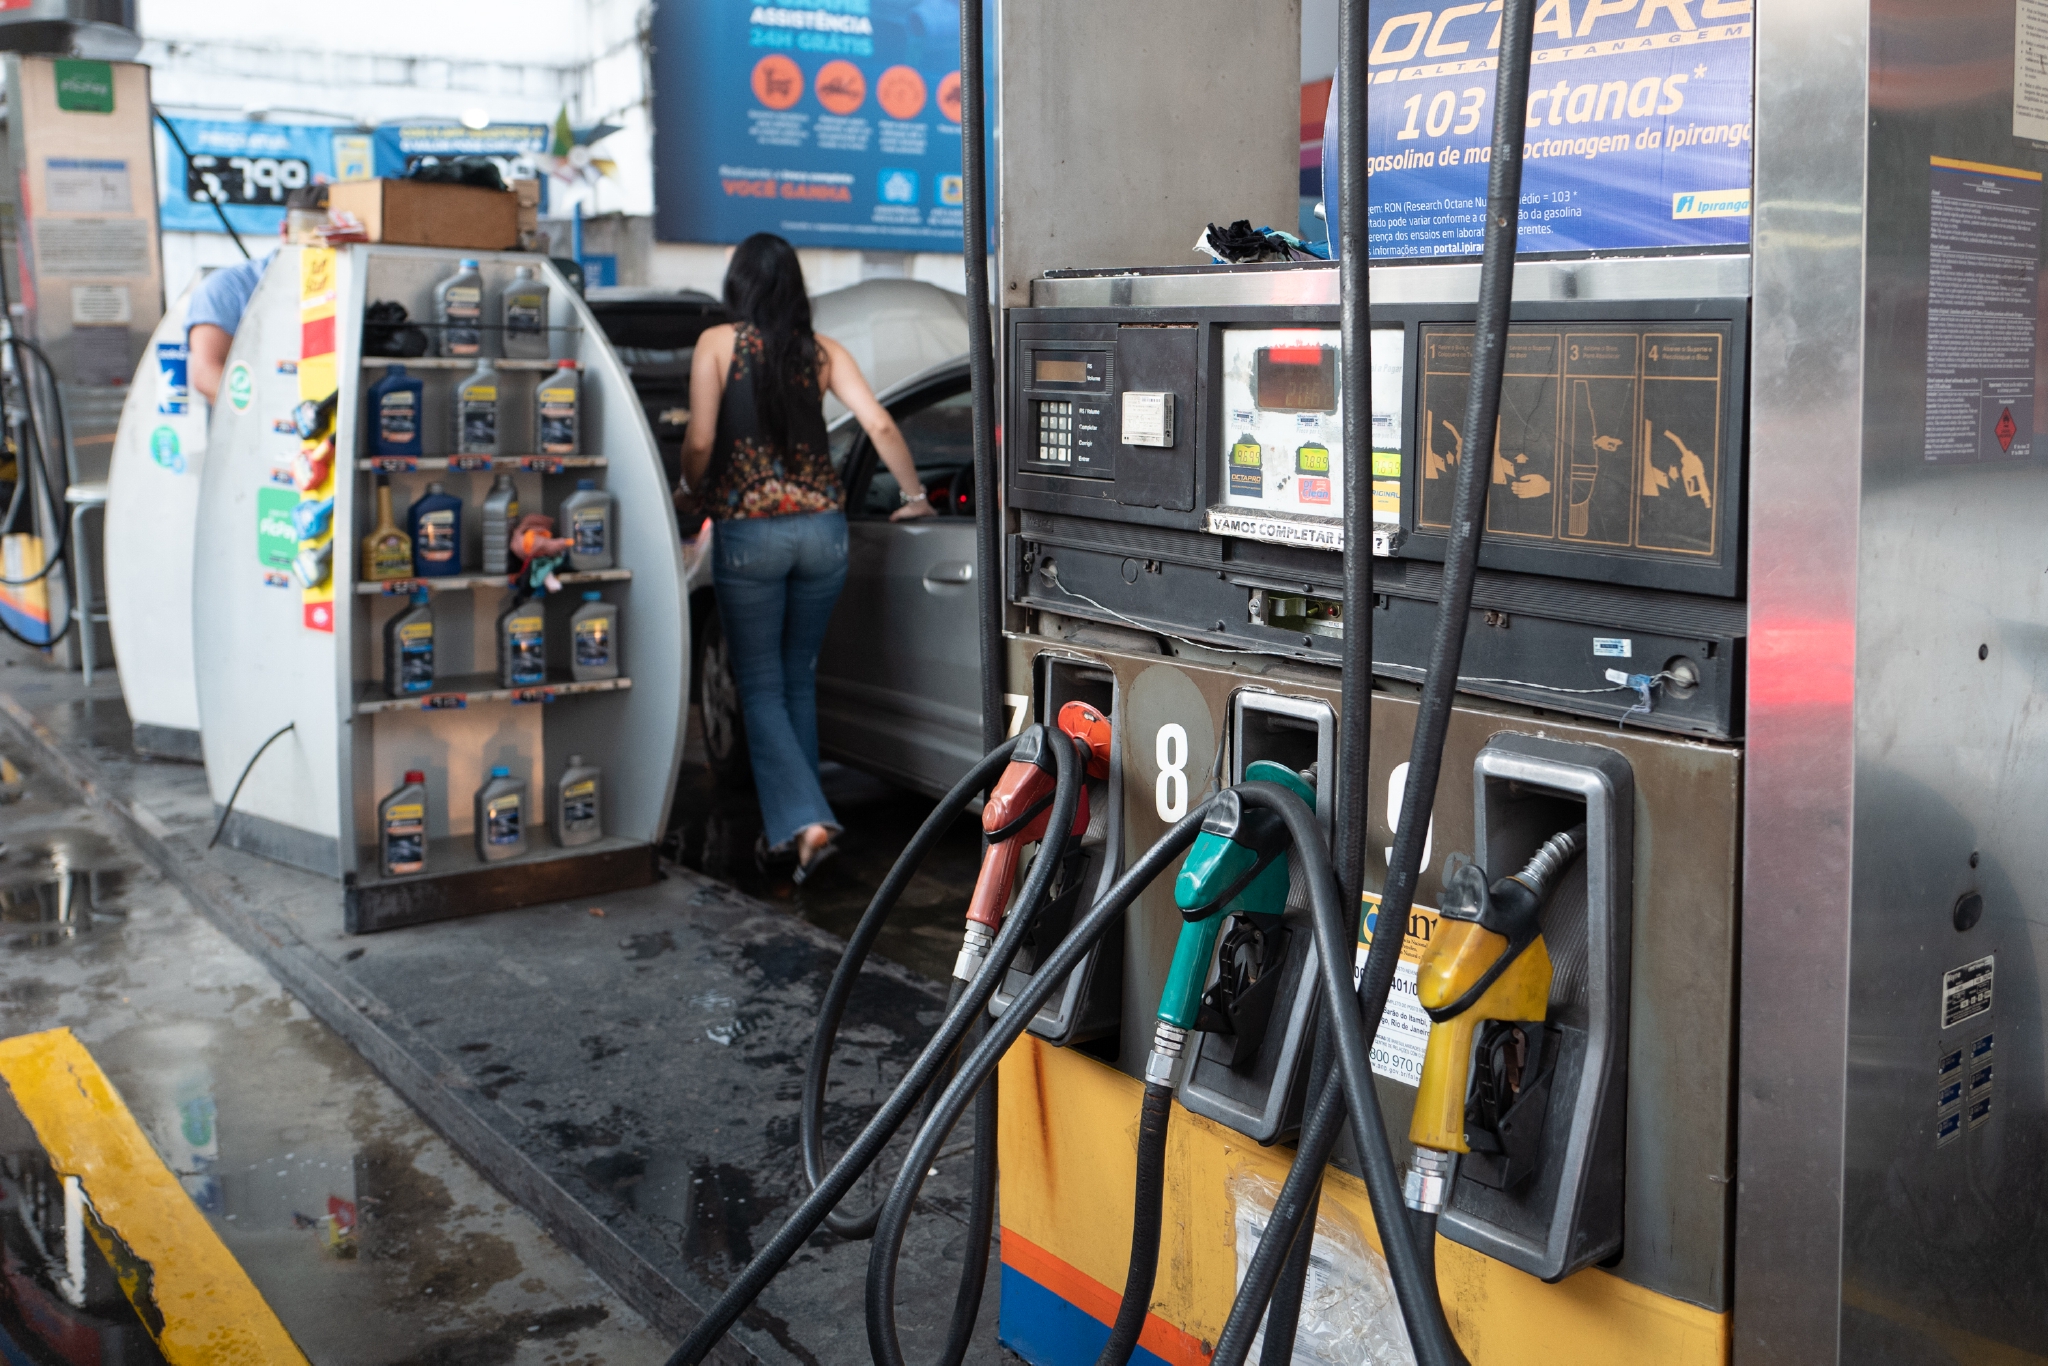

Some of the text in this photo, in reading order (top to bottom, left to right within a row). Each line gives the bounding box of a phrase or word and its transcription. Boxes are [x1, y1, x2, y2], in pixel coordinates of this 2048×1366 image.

[1412, 60, 1489, 77] ALTA
[1397, 87, 1486, 141] 103
[1438, 147, 1460, 166] de
[1635, 127, 1662, 150] da
[1551, 191, 1570, 203] 103
[1385, 202, 1402, 212] RON
[1403, 199, 1442, 214] (Research
[1444, 198, 1473, 210] Octane
[1531, 208, 1542, 219] da
[1544, 205, 1582, 221] gasolina
[1697, 200, 1750, 214] Ipiranga
[1388, 216, 1407, 230] pode
[1409, 214, 1432, 226] variar
[1433, 212, 1471, 225] conforme
[1473, 214, 1478, 222] a
[1395, 230, 1409, 241] dos
[1410, 227, 1441, 240] ensaios
[1442, 229, 1455, 239] em
[1372, 243, 1418, 257] informações
[1420, 244, 1432, 254] em
[1430, 344, 1436, 358] 1
[1570, 345, 1579, 361] 3
[1648, 345, 1659, 361] 4
[1304, 454, 1329, 468] 7.899
[1231, 473, 1262, 482] OCTAPRO
[1302, 488, 1329, 499] Clean
[1372, 490, 1400, 498] RIGINAL
[1214, 518, 1256, 534] VAMOS
[1259, 522, 1334, 545] COMPLETAR
[1155, 723, 1189, 822] 8
[1391, 1018, 1400, 1028] Rio
[1401, 1022, 1409, 1030] de
[1392, 1054, 1413, 1072] 970
